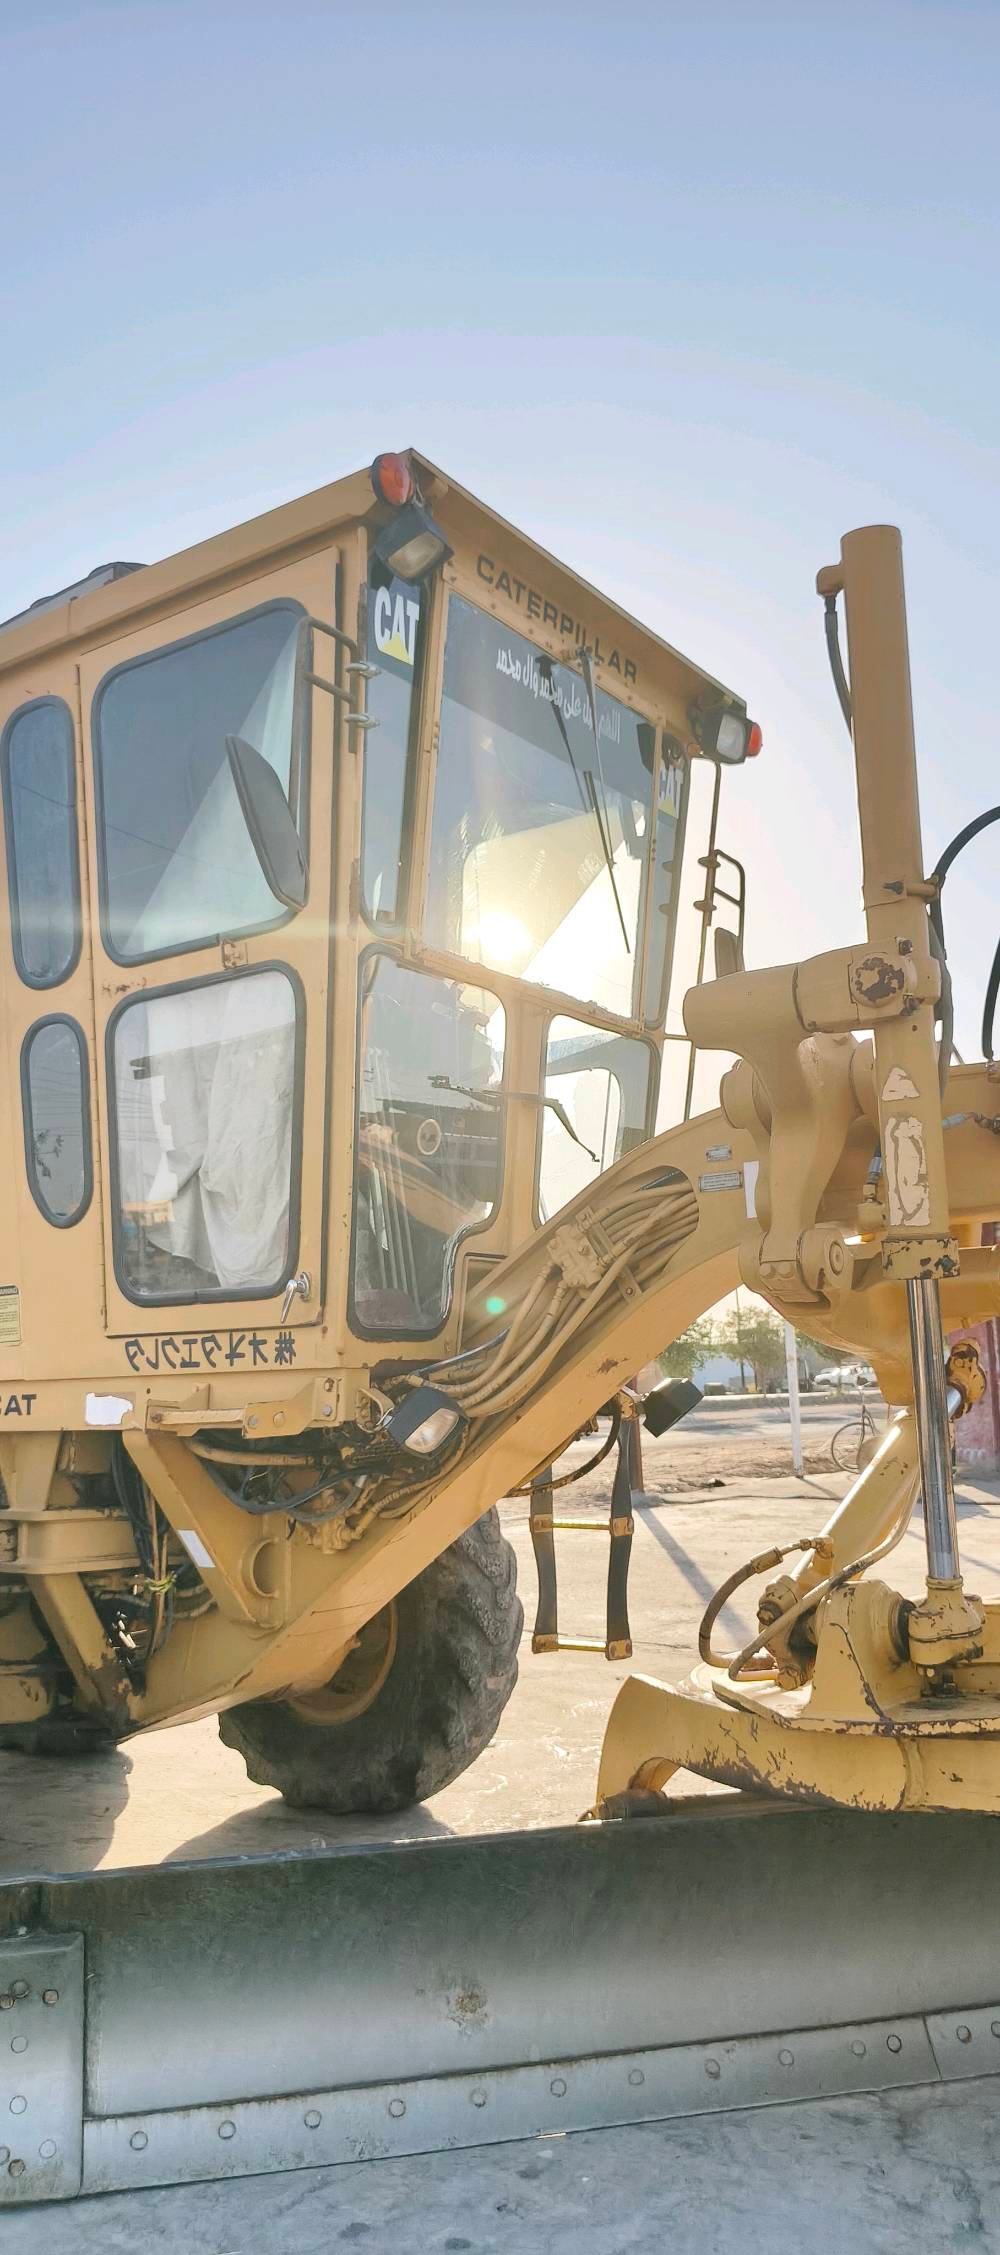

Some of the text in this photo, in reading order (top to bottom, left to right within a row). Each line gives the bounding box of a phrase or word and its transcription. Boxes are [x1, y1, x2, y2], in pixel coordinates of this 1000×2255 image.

[374, 585, 420, 665] CAT
[476, 553, 639, 684] CATERPILLAR
[496, 648, 522, 682] محمد
[0, 1393, 37, 1416] AT
